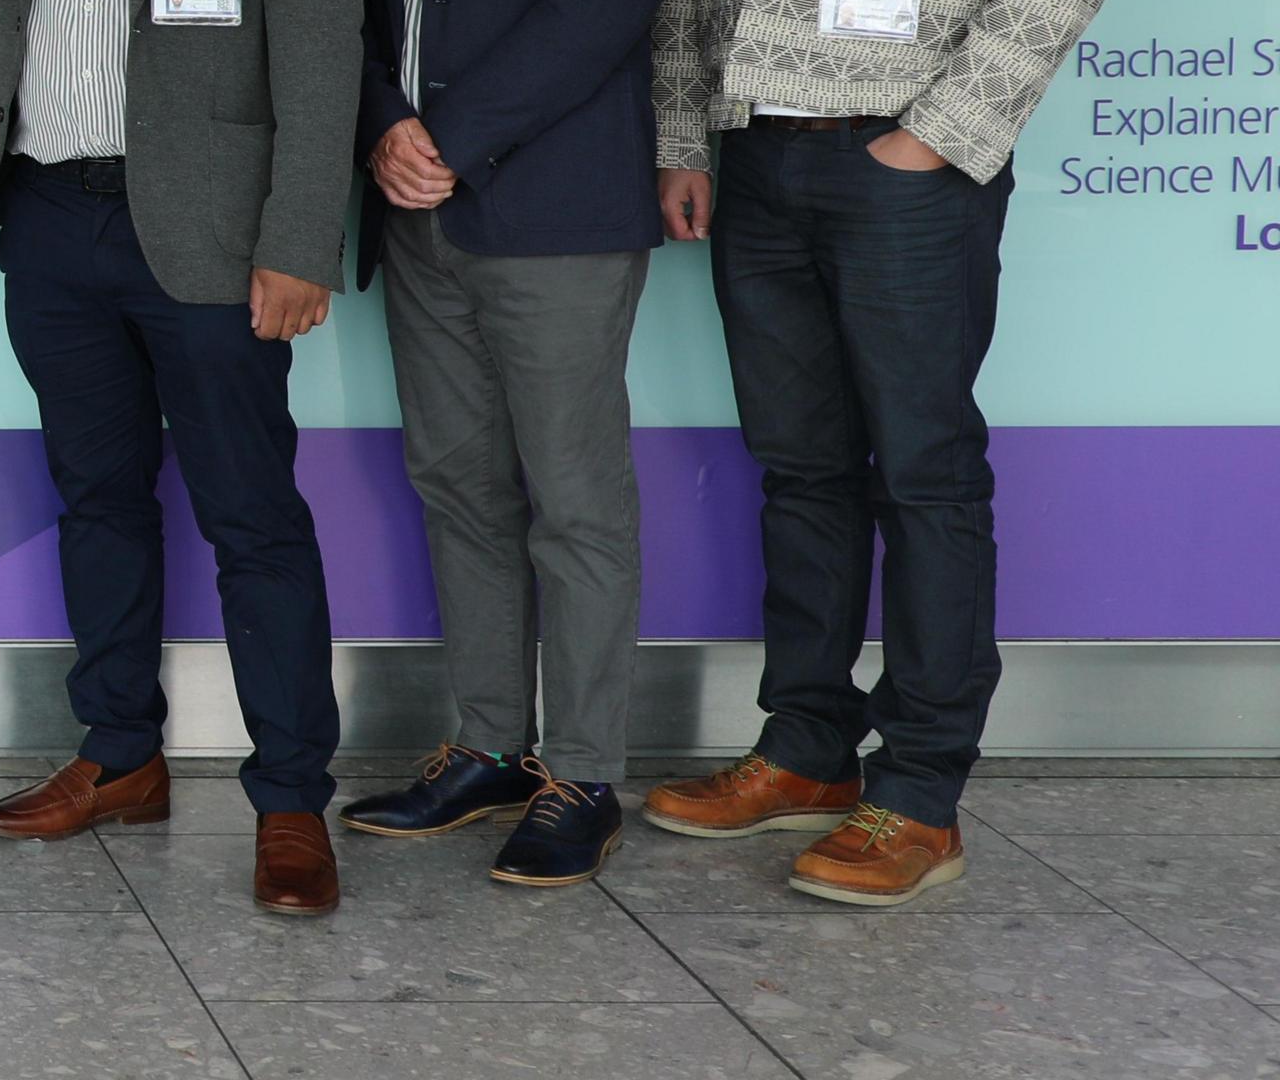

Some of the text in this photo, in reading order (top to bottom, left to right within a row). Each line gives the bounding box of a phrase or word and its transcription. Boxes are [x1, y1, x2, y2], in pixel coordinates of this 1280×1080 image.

[1076, 37, 1280, 78] Rachael S
[1092, 96, 1280, 146] Explainer
[1059, 156, 1280, 195] Science M
